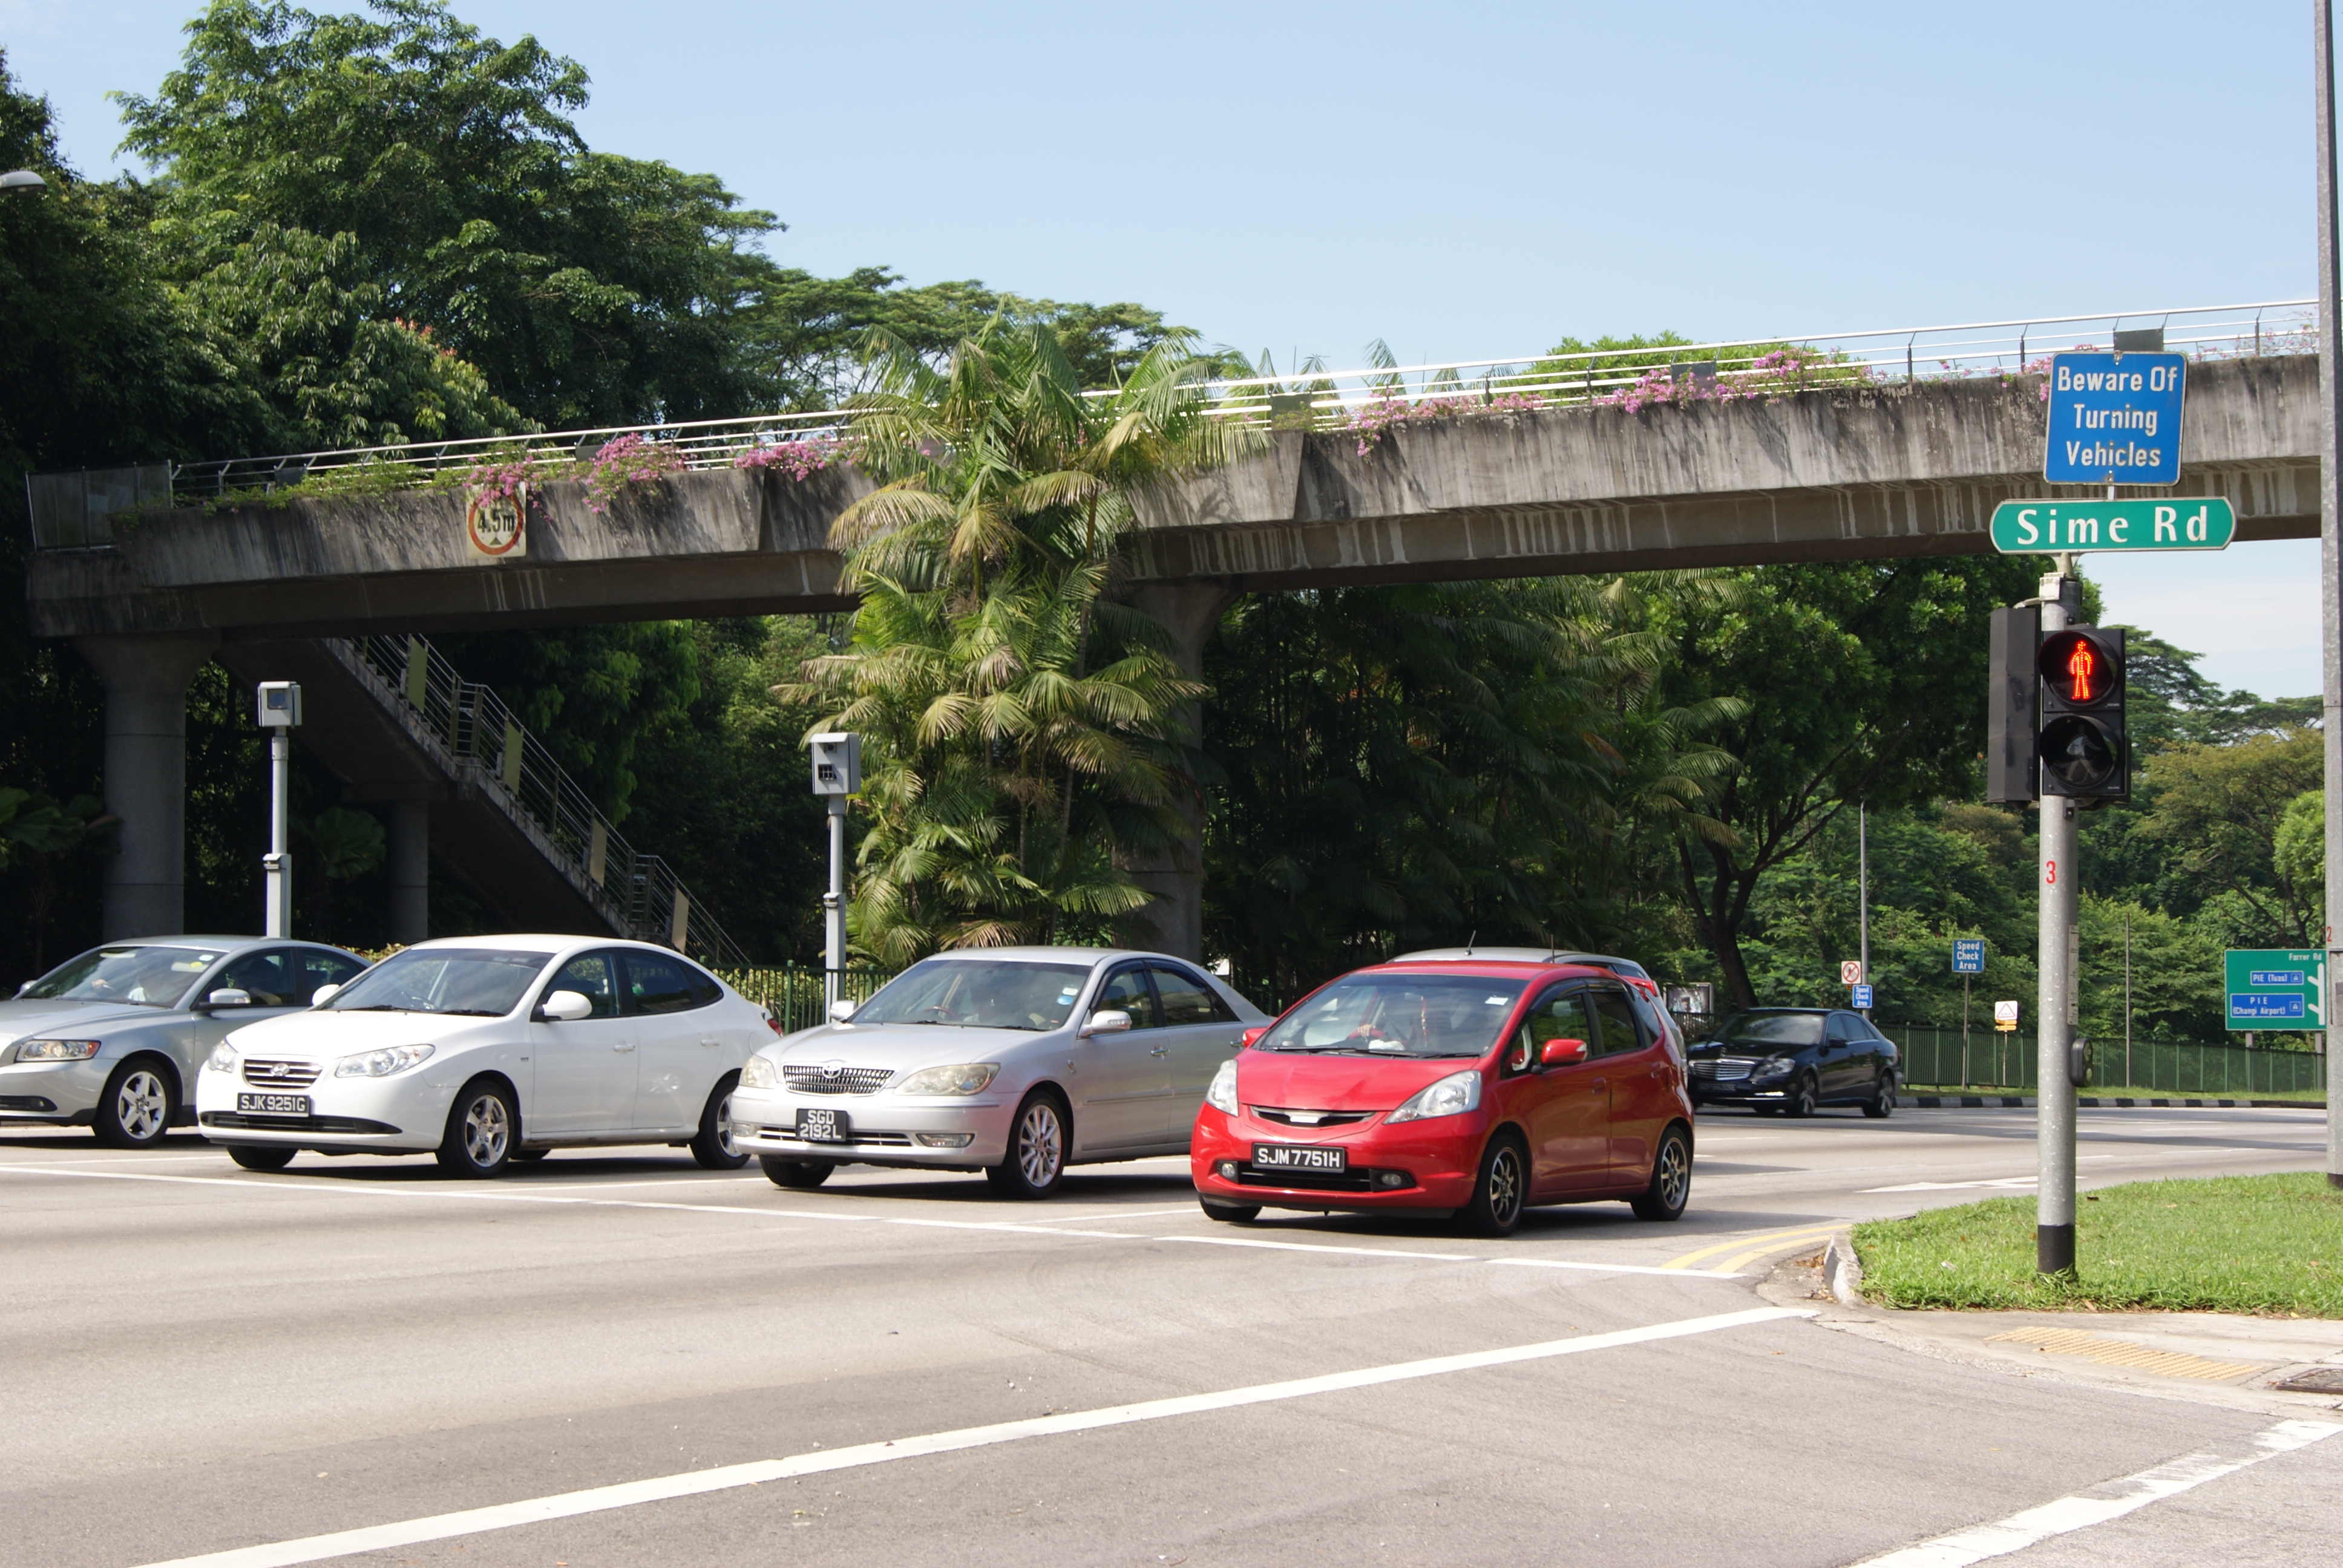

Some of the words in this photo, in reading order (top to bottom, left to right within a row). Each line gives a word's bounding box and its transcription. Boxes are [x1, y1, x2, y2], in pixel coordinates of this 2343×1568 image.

[2058, 366, 2142, 391] Beware
[2150, 366, 2178, 392] Of
[2074, 403, 2158, 437] Turning
[2066, 441, 2161, 468] Vehicles
[2017, 508, 2129, 545] Sime
[2154, 505, 2207, 542] Rd
[2046, 861, 2056, 884] 3
[2327, 926, 2332, 942] 2
[1957, 941, 1979, 953] Speed
[1957, 951, 1979, 960] Check
[1959, 961, 1976, 970] Area
[2268, 973, 2287, 982] (Tuas)
[2233, 1007, 2257, 1016] (Changi
[2260, 1007, 2286, 1016] Airport)
[807, 1109, 834, 1125] SGD
